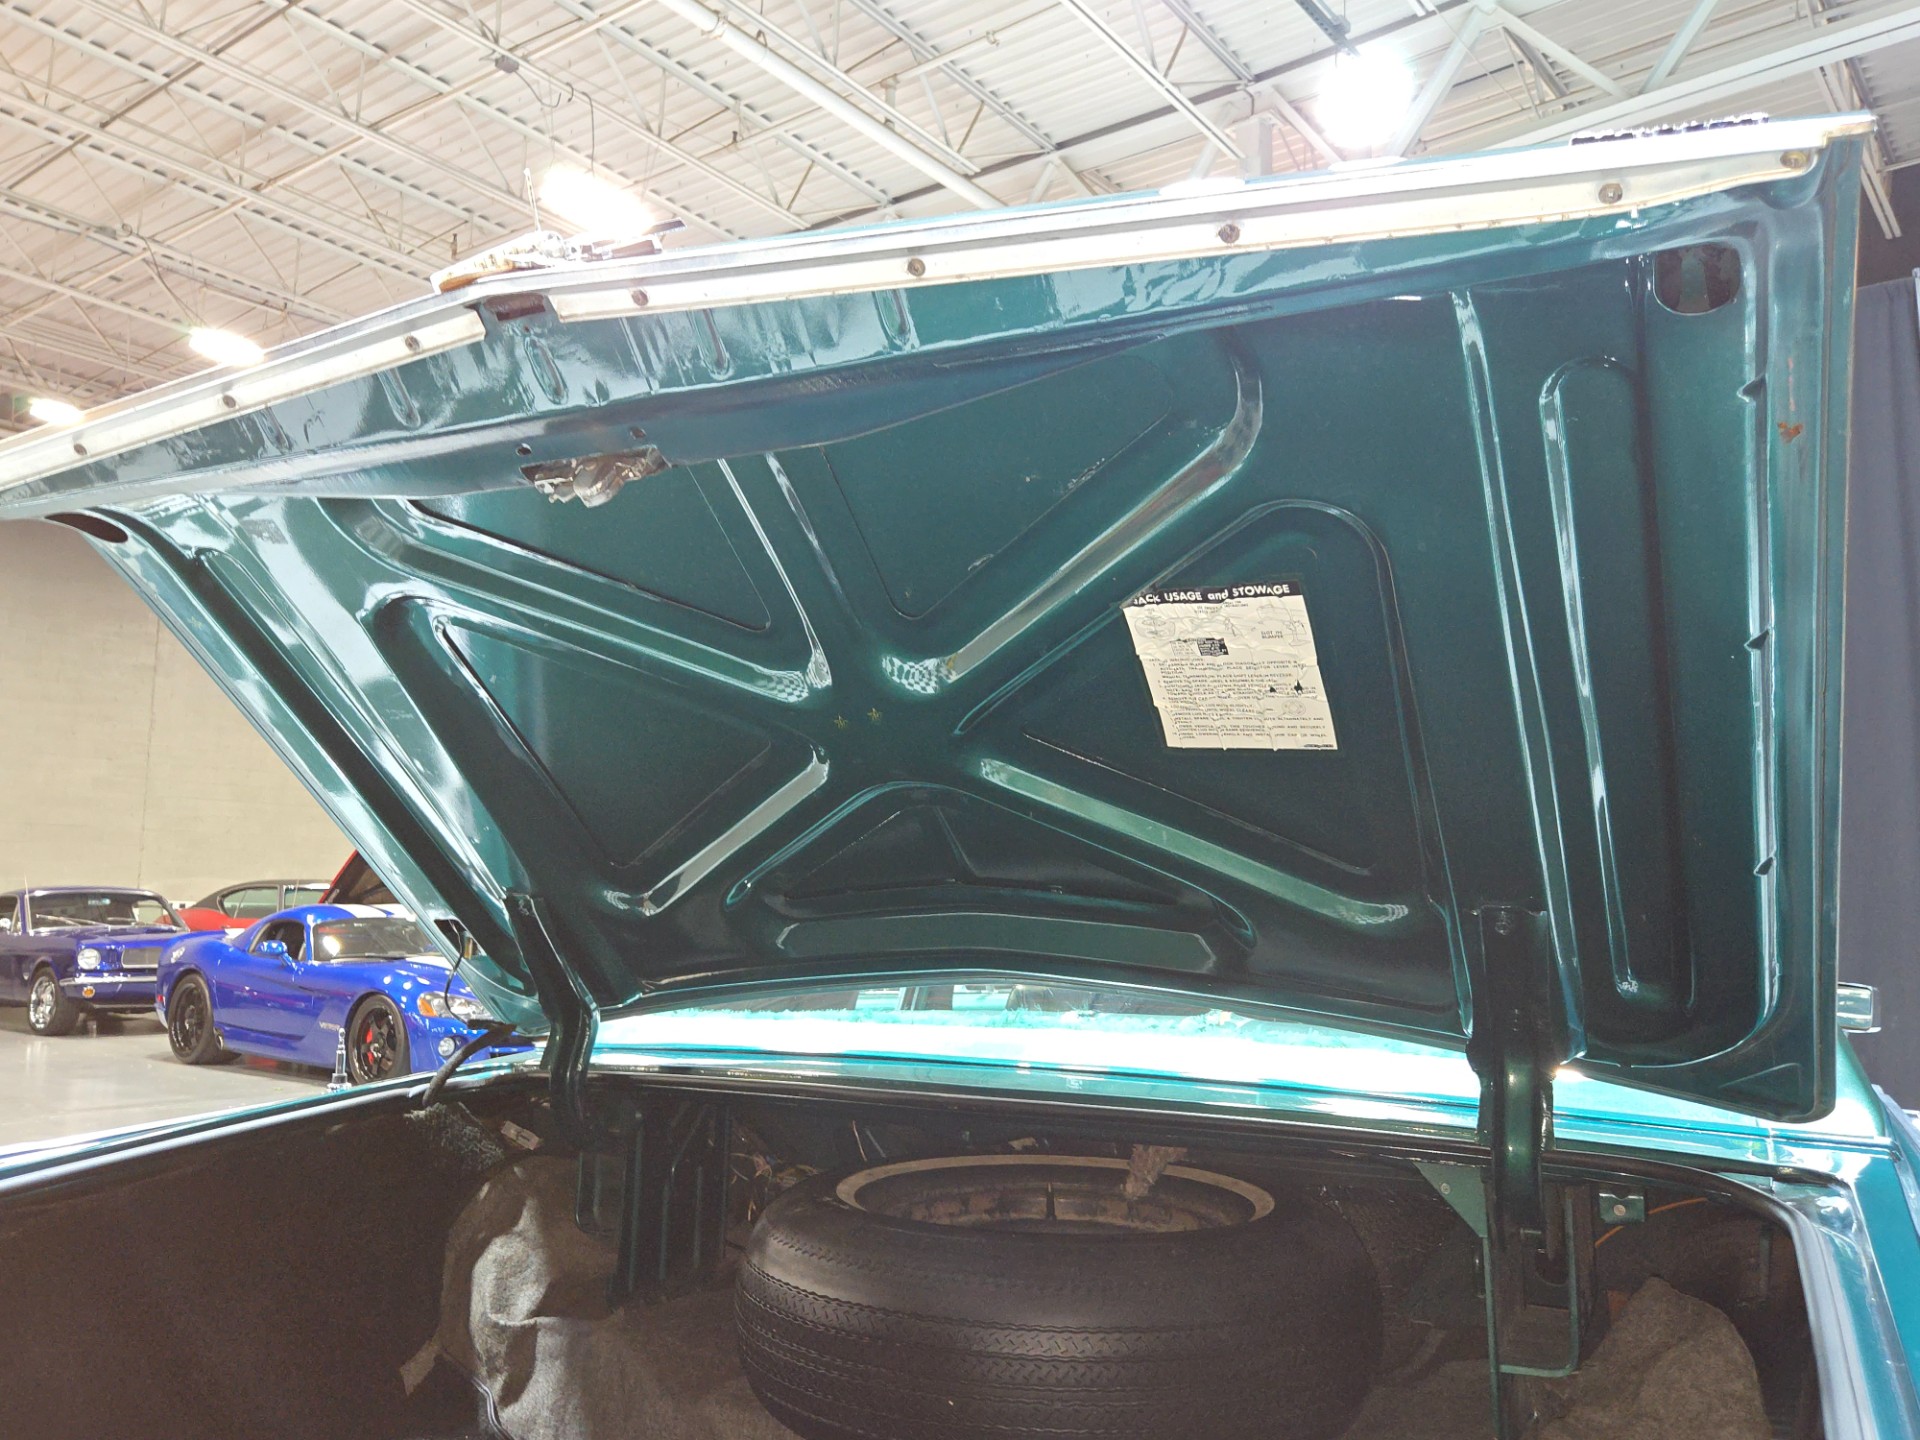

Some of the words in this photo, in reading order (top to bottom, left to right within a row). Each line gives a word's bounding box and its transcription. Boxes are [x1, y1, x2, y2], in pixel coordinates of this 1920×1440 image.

[1164, 591, 1203, 603] USAGE
[1207, 589, 1229, 601] and
[1232, 584, 1290, 597] STOWAGE
